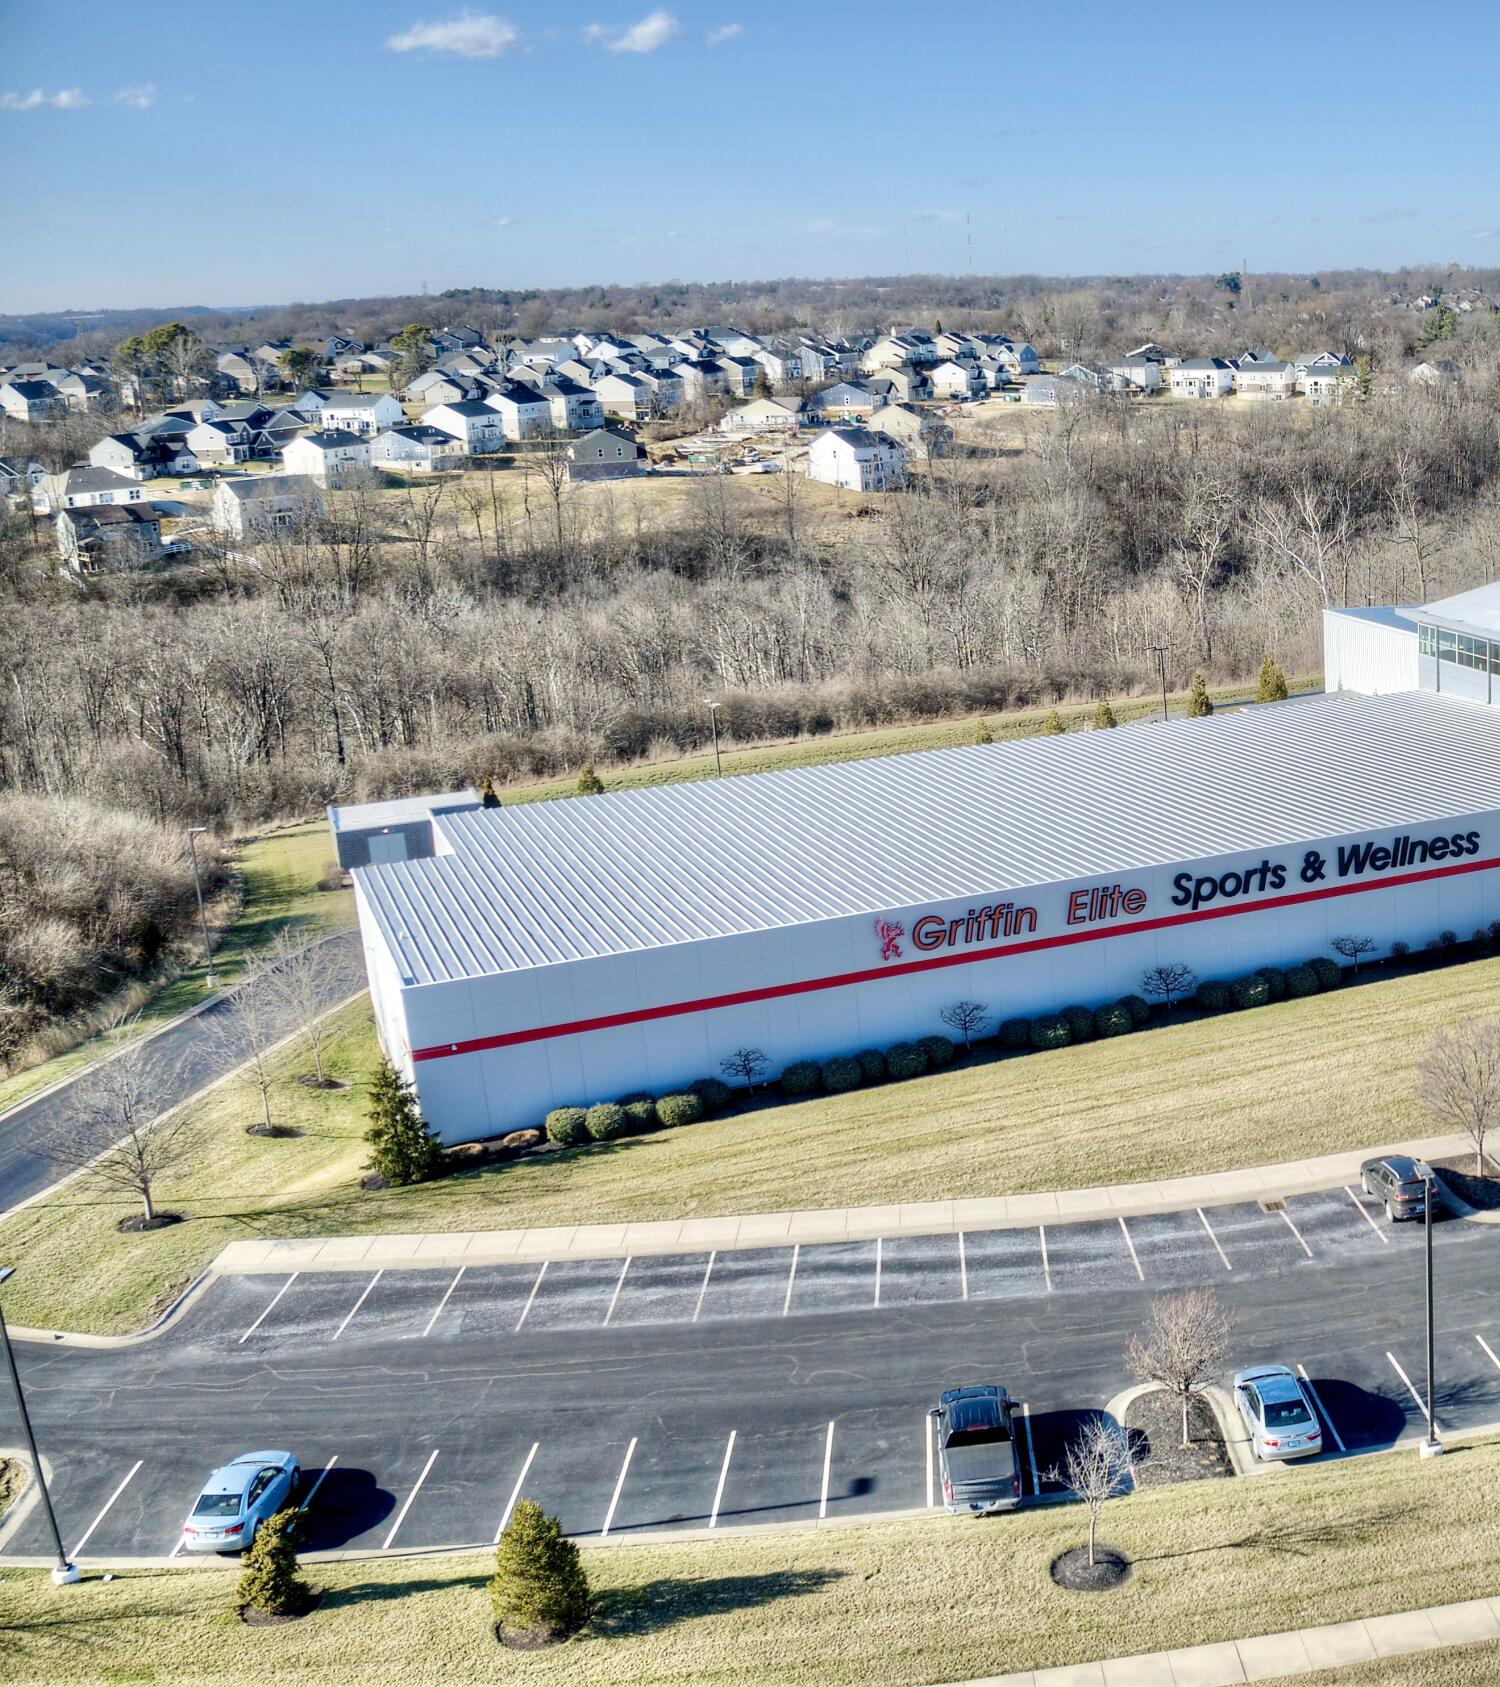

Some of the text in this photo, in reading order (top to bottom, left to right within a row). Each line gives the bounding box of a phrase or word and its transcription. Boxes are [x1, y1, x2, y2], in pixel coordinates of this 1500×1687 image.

[912, 831, 1481, 951] Griffin Elite Sports & Wellness
